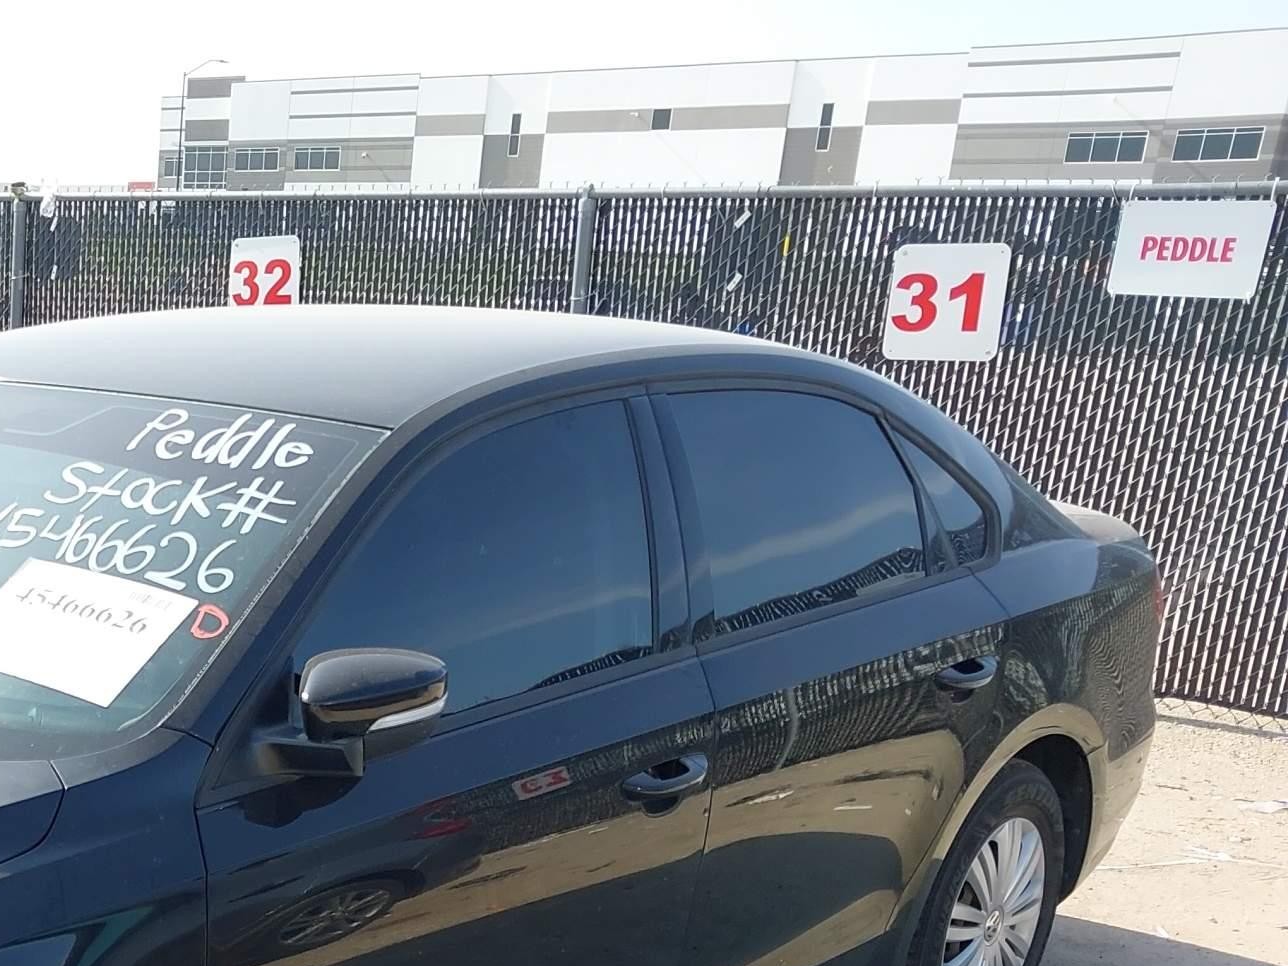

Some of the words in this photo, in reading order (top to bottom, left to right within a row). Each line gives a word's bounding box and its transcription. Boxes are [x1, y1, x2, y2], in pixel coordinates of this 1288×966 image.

[1139, 235, 1237, 263] PEDDLE
[232, 258, 293, 307] 32
[891, 272, 986, 333] 31
[125, 407, 314, 470] Peddle
[189, 604, 230, 639] D
